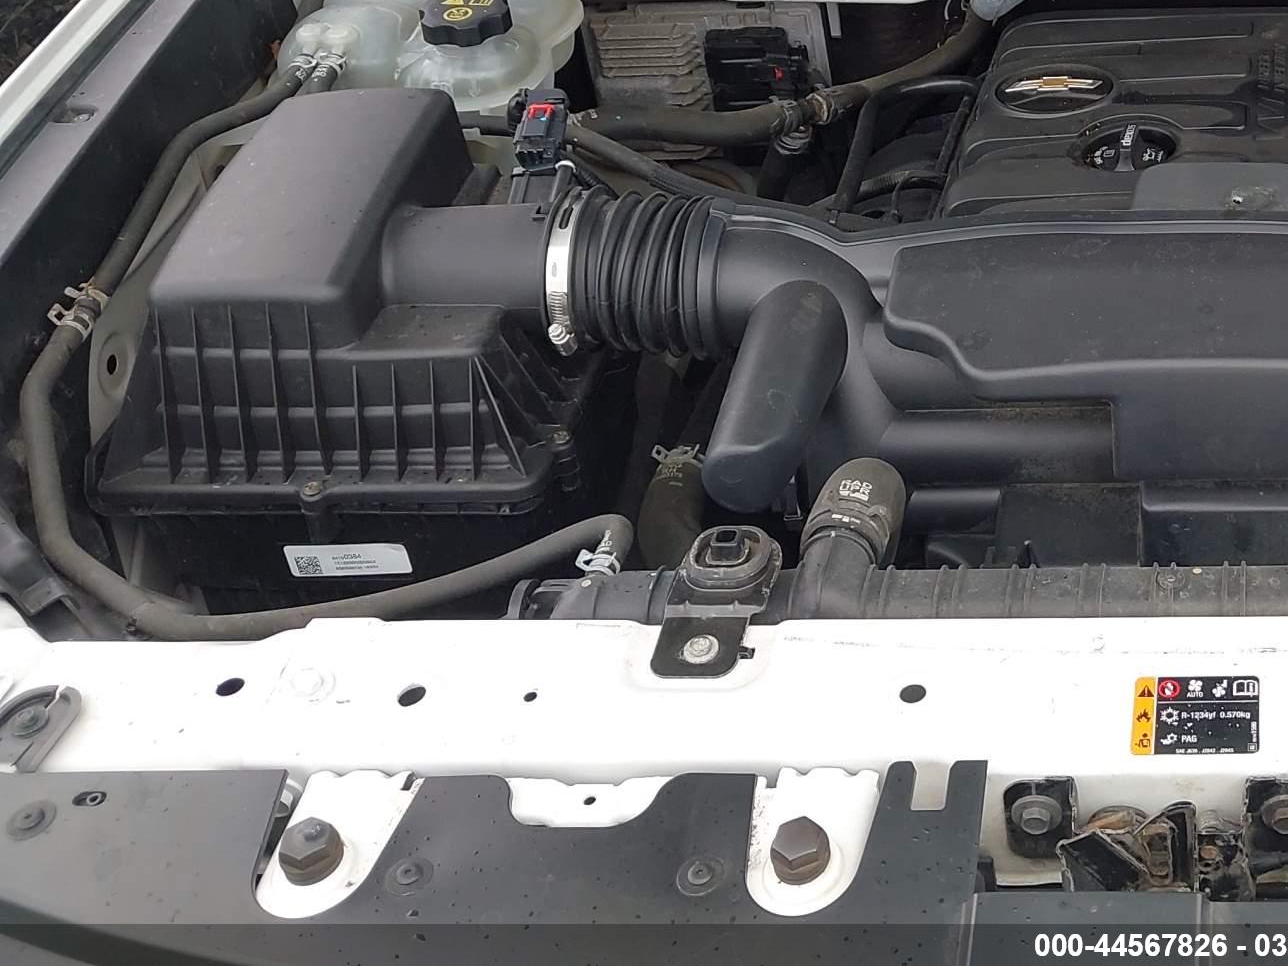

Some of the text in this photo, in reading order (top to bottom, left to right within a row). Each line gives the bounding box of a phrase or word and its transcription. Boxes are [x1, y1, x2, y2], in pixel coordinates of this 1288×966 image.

[1181, 710, 1251, 720] R-1234yf 0.570kg
[1181, 735, 1197, 743] PAG
